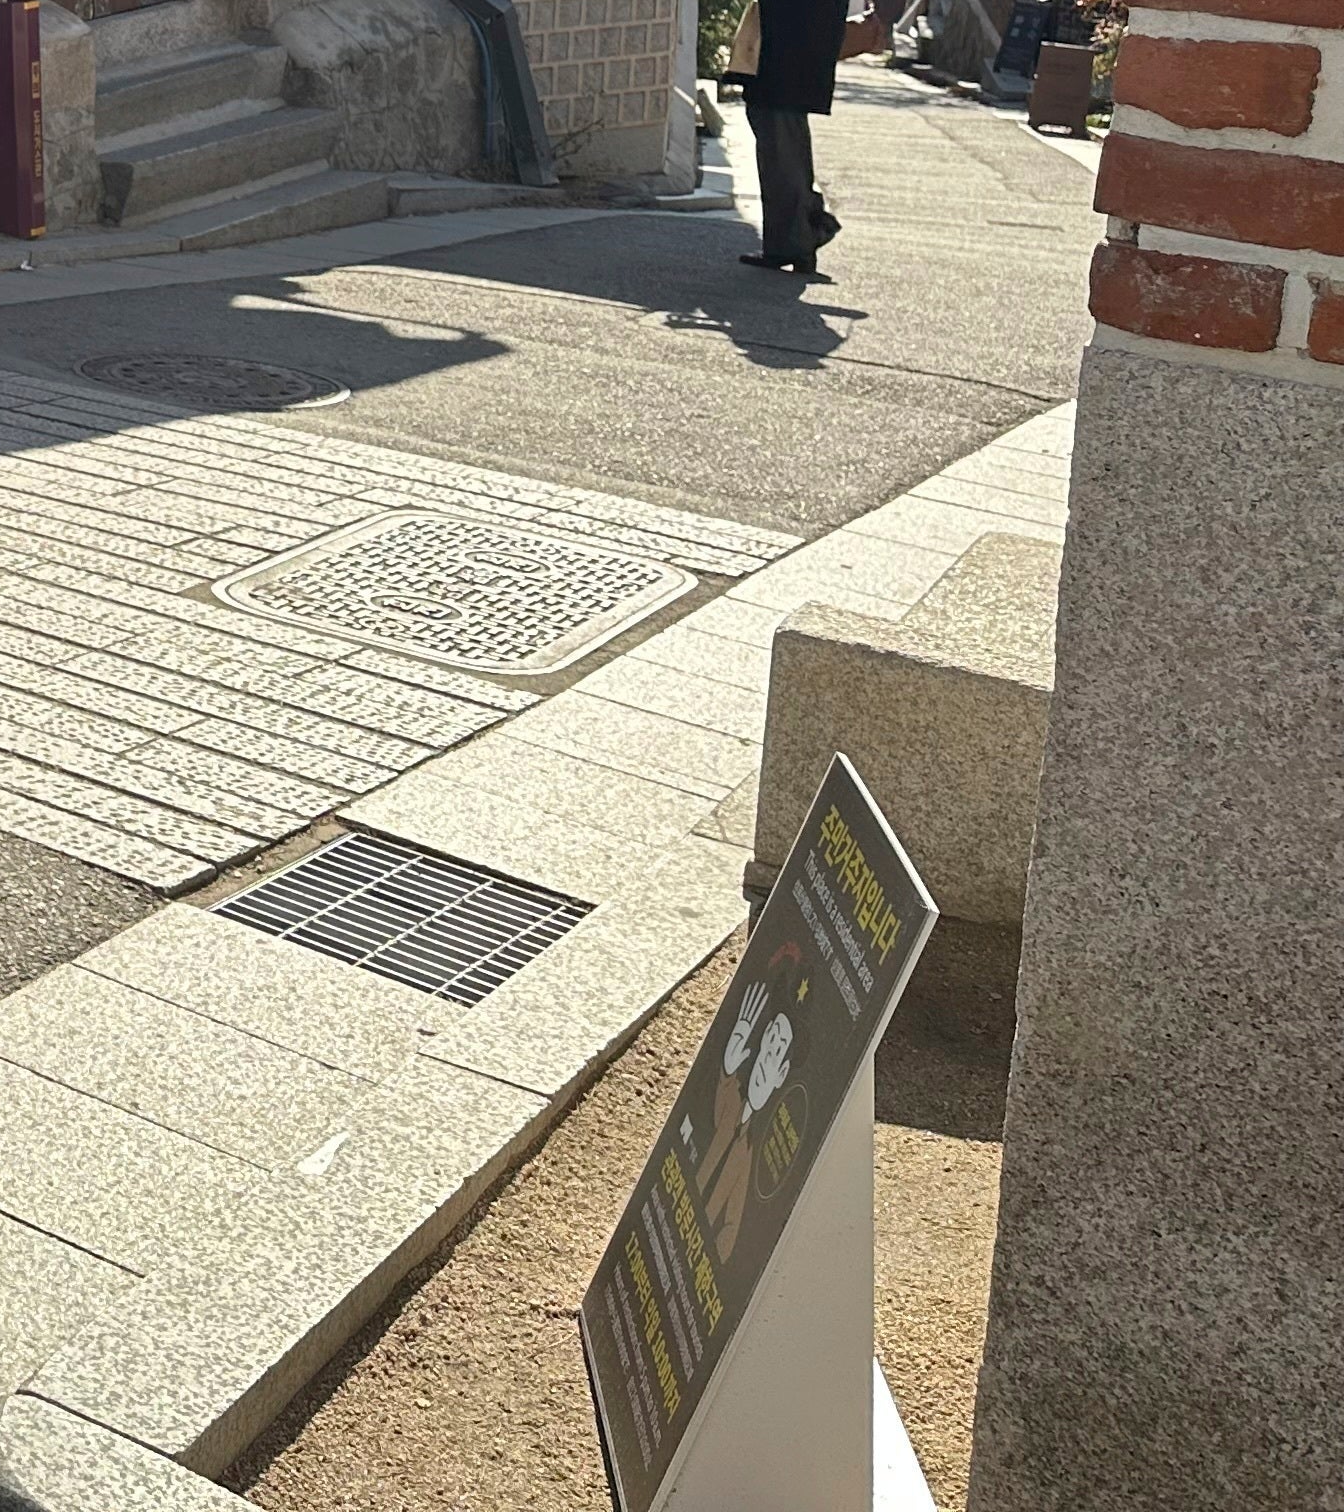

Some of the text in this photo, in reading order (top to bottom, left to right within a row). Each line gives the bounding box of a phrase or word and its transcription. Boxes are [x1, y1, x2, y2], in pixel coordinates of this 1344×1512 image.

[805, 849, 817, 880] This
[811, 872, 830, 905] place
[833, 912, 865, 970] residential
[858, 962, 873, 993] area
[625, 1232, 652, 1311] 17:00부터
[661, 1148, 686, 1210] 관광객
[676, 1191, 704, 1268] 방문시간
[695, 1253, 723, 1335] 제한구역
[645, 1298, 660, 1343] 익일
[652, 1331, 680, 1423] 10:00까지
